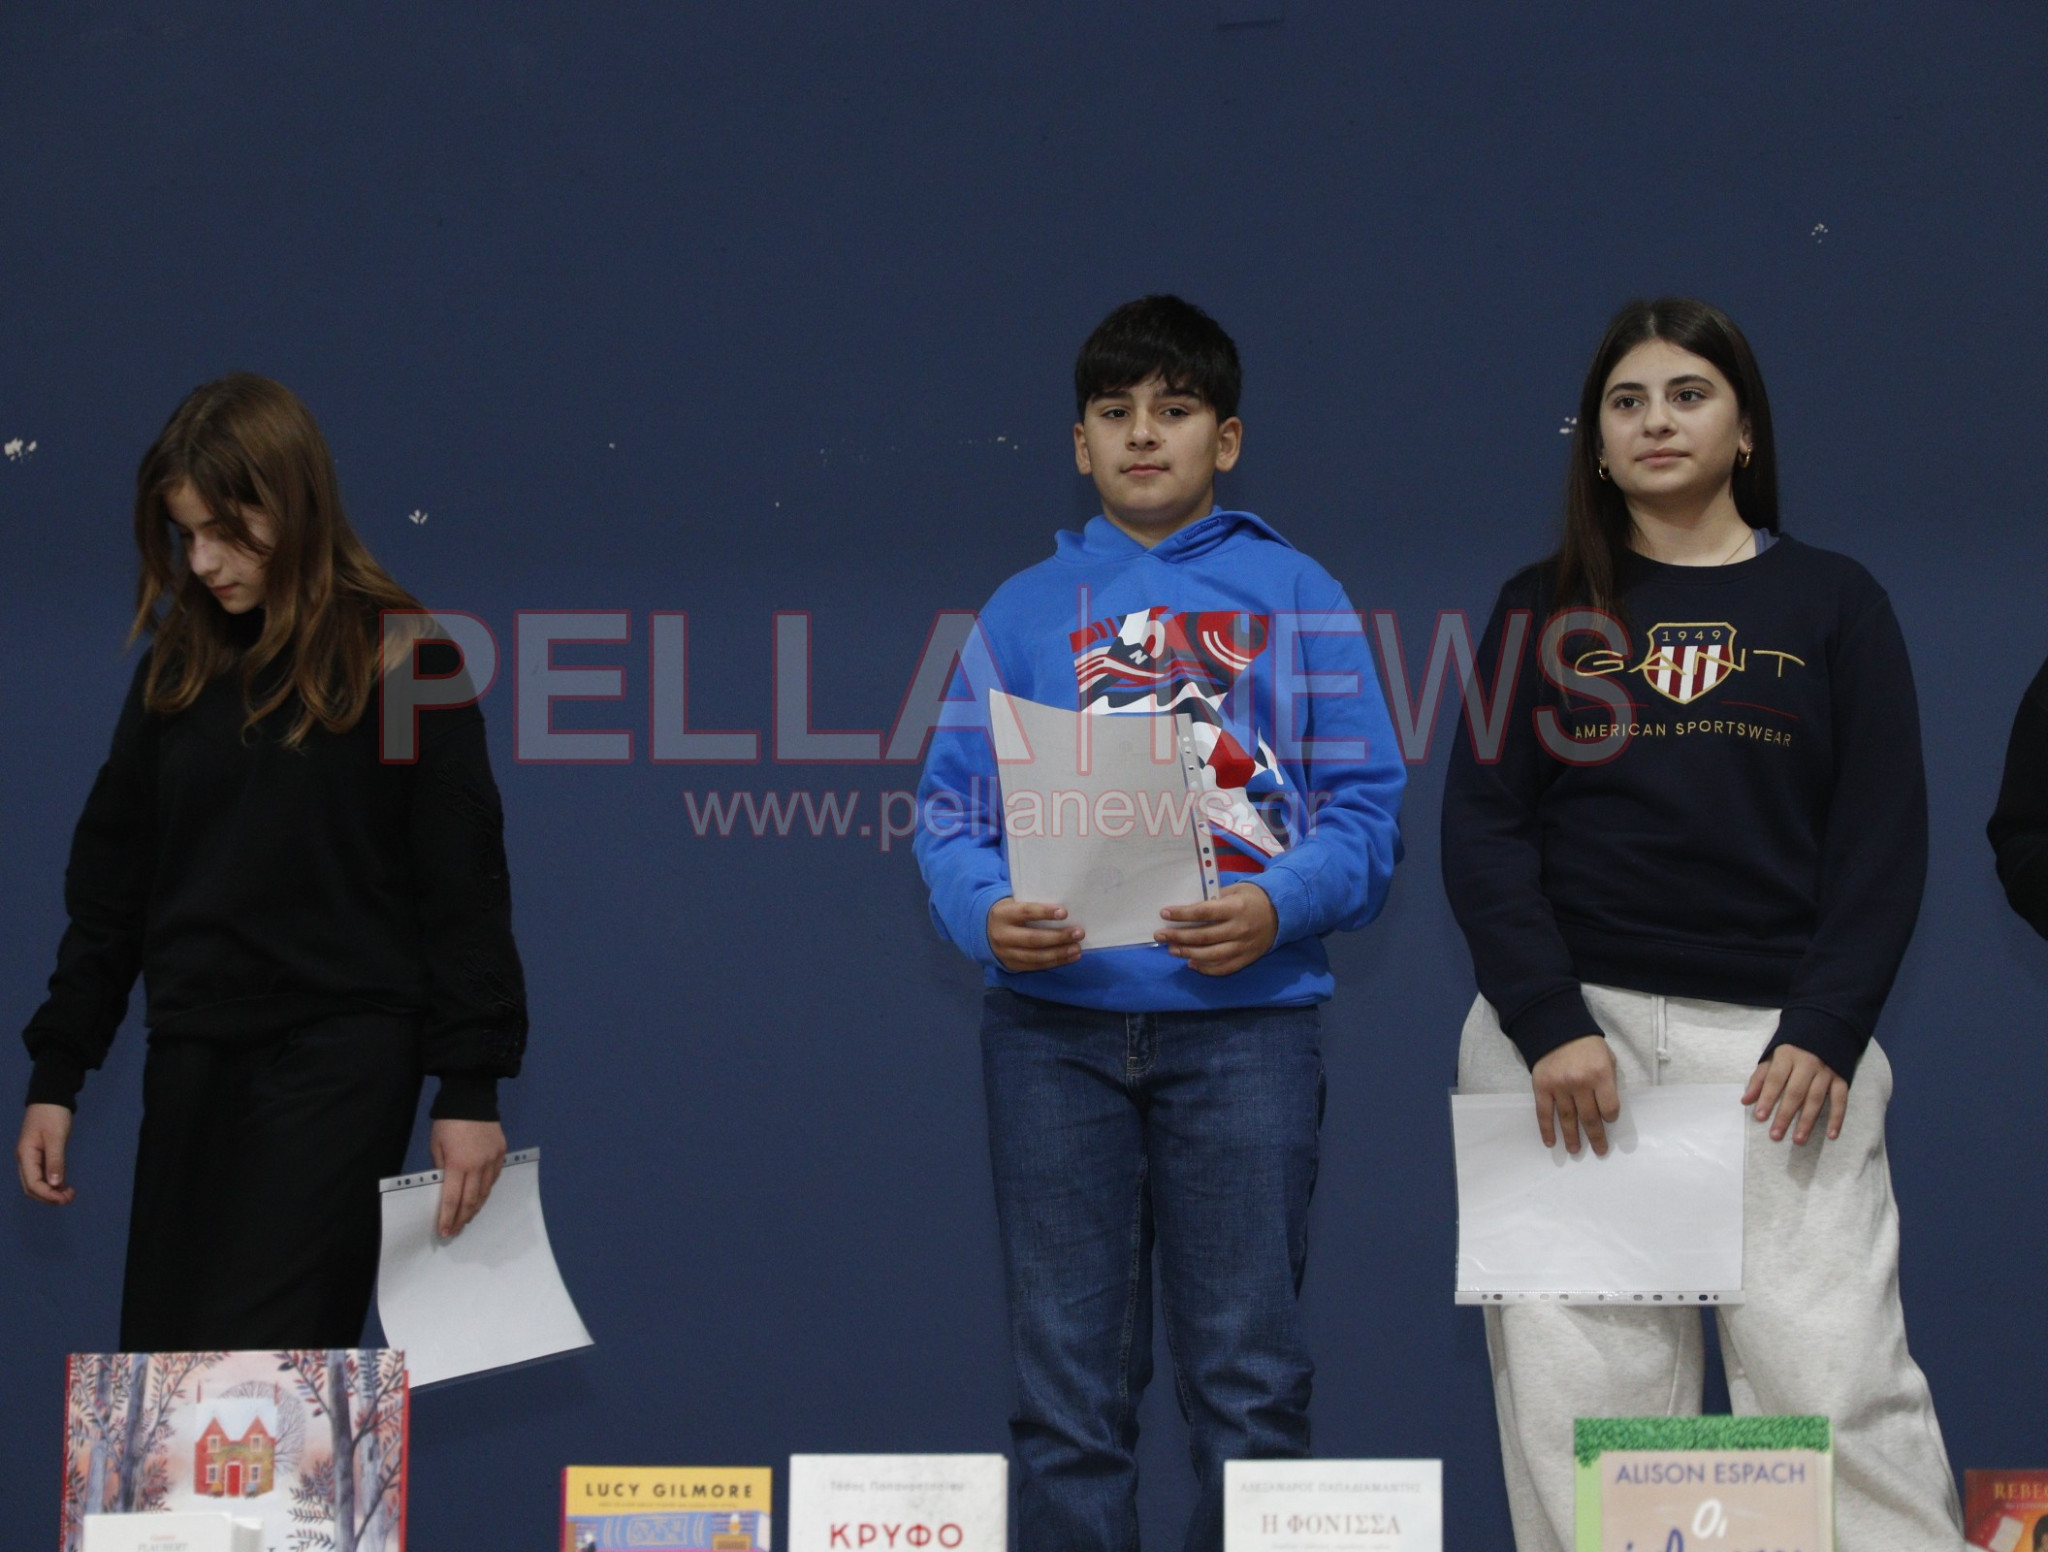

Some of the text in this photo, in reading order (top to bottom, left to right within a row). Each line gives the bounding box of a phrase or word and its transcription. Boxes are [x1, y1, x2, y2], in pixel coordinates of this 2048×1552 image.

[1662, 630, 1721, 642] 1949
[1575, 648, 1805, 677] GANT
[1575, 720, 1791, 747] AMERICAN SPORTSWEAR
[1615, 1463, 1805, 1484] ALISON ESPACH
[586, 1483, 752, 1498] LUCY GILMORE
[1261, 1513, 1401, 1535] Η ΦΟΝΙΣΣΑ
[830, 1523, 963, 1549] ΚΡΥΦΟ
